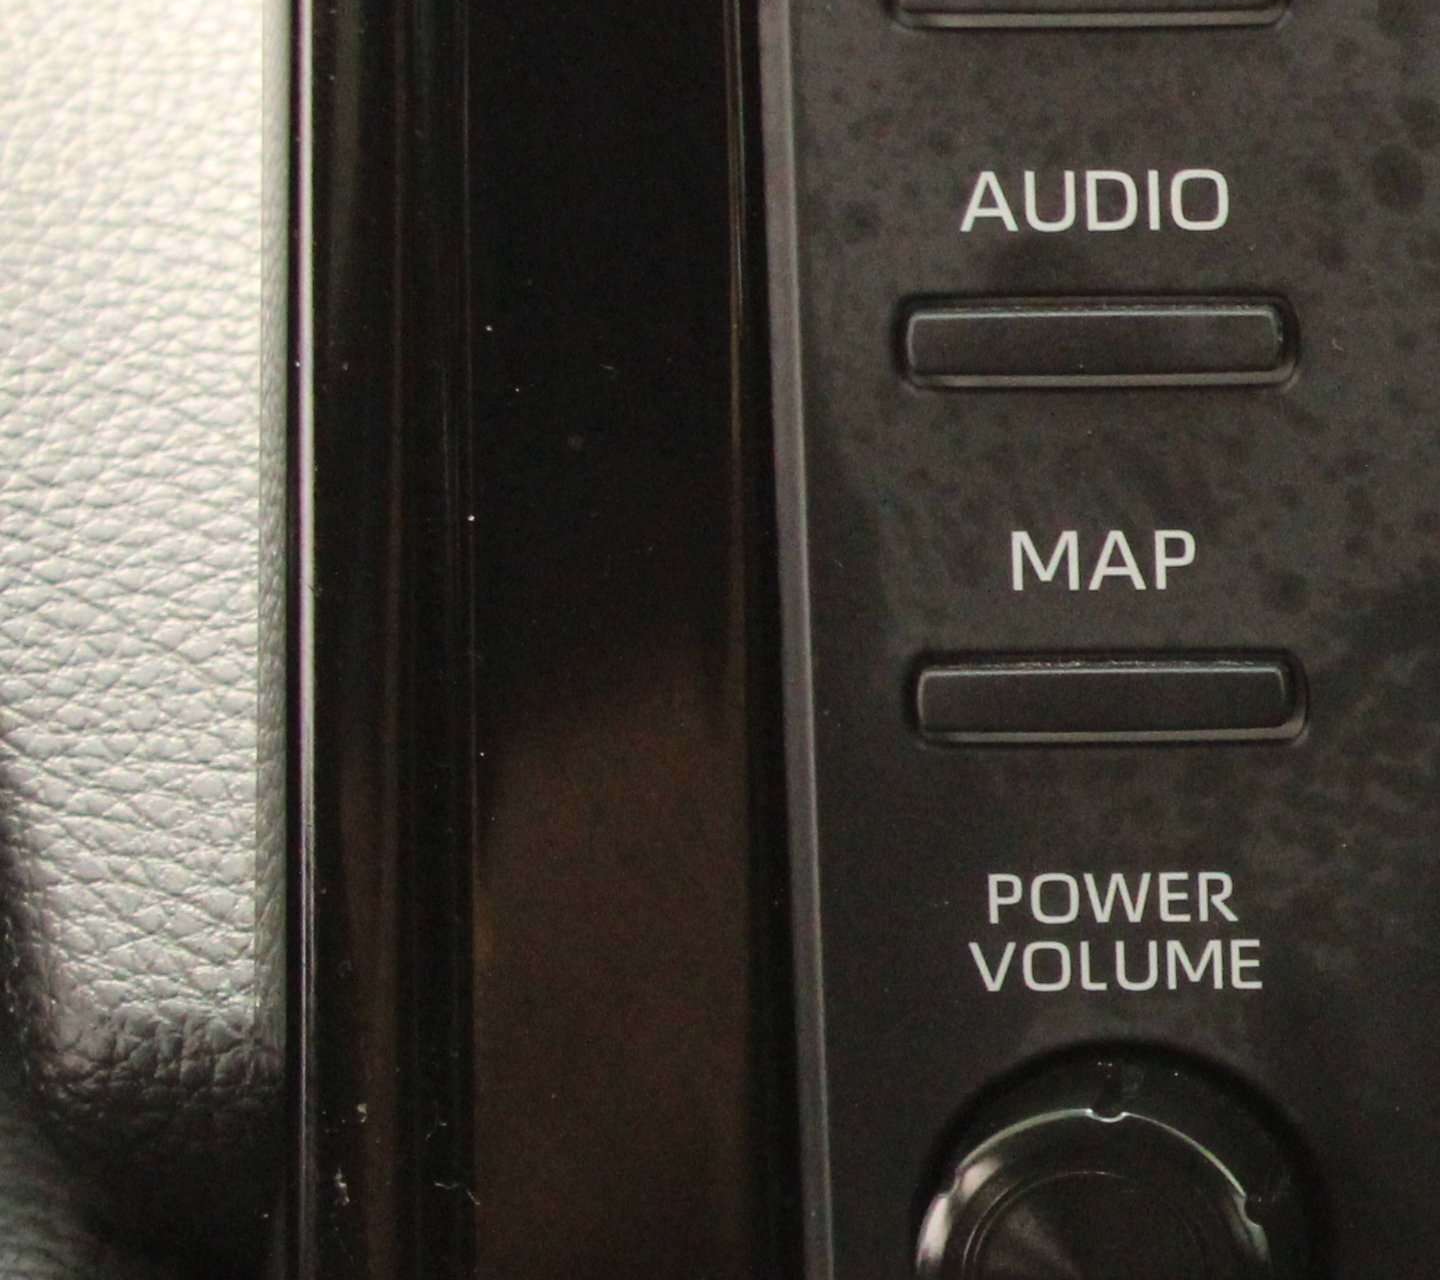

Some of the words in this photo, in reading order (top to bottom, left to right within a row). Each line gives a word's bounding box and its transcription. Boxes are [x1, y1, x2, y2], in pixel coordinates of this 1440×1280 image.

[960, 168, 1230, 232] AUDIO
[1011, 529, 1196, 591] MAP
[987, 871, 1238, 924] POWER
[969, 939, 1263, 992] VOLUME
